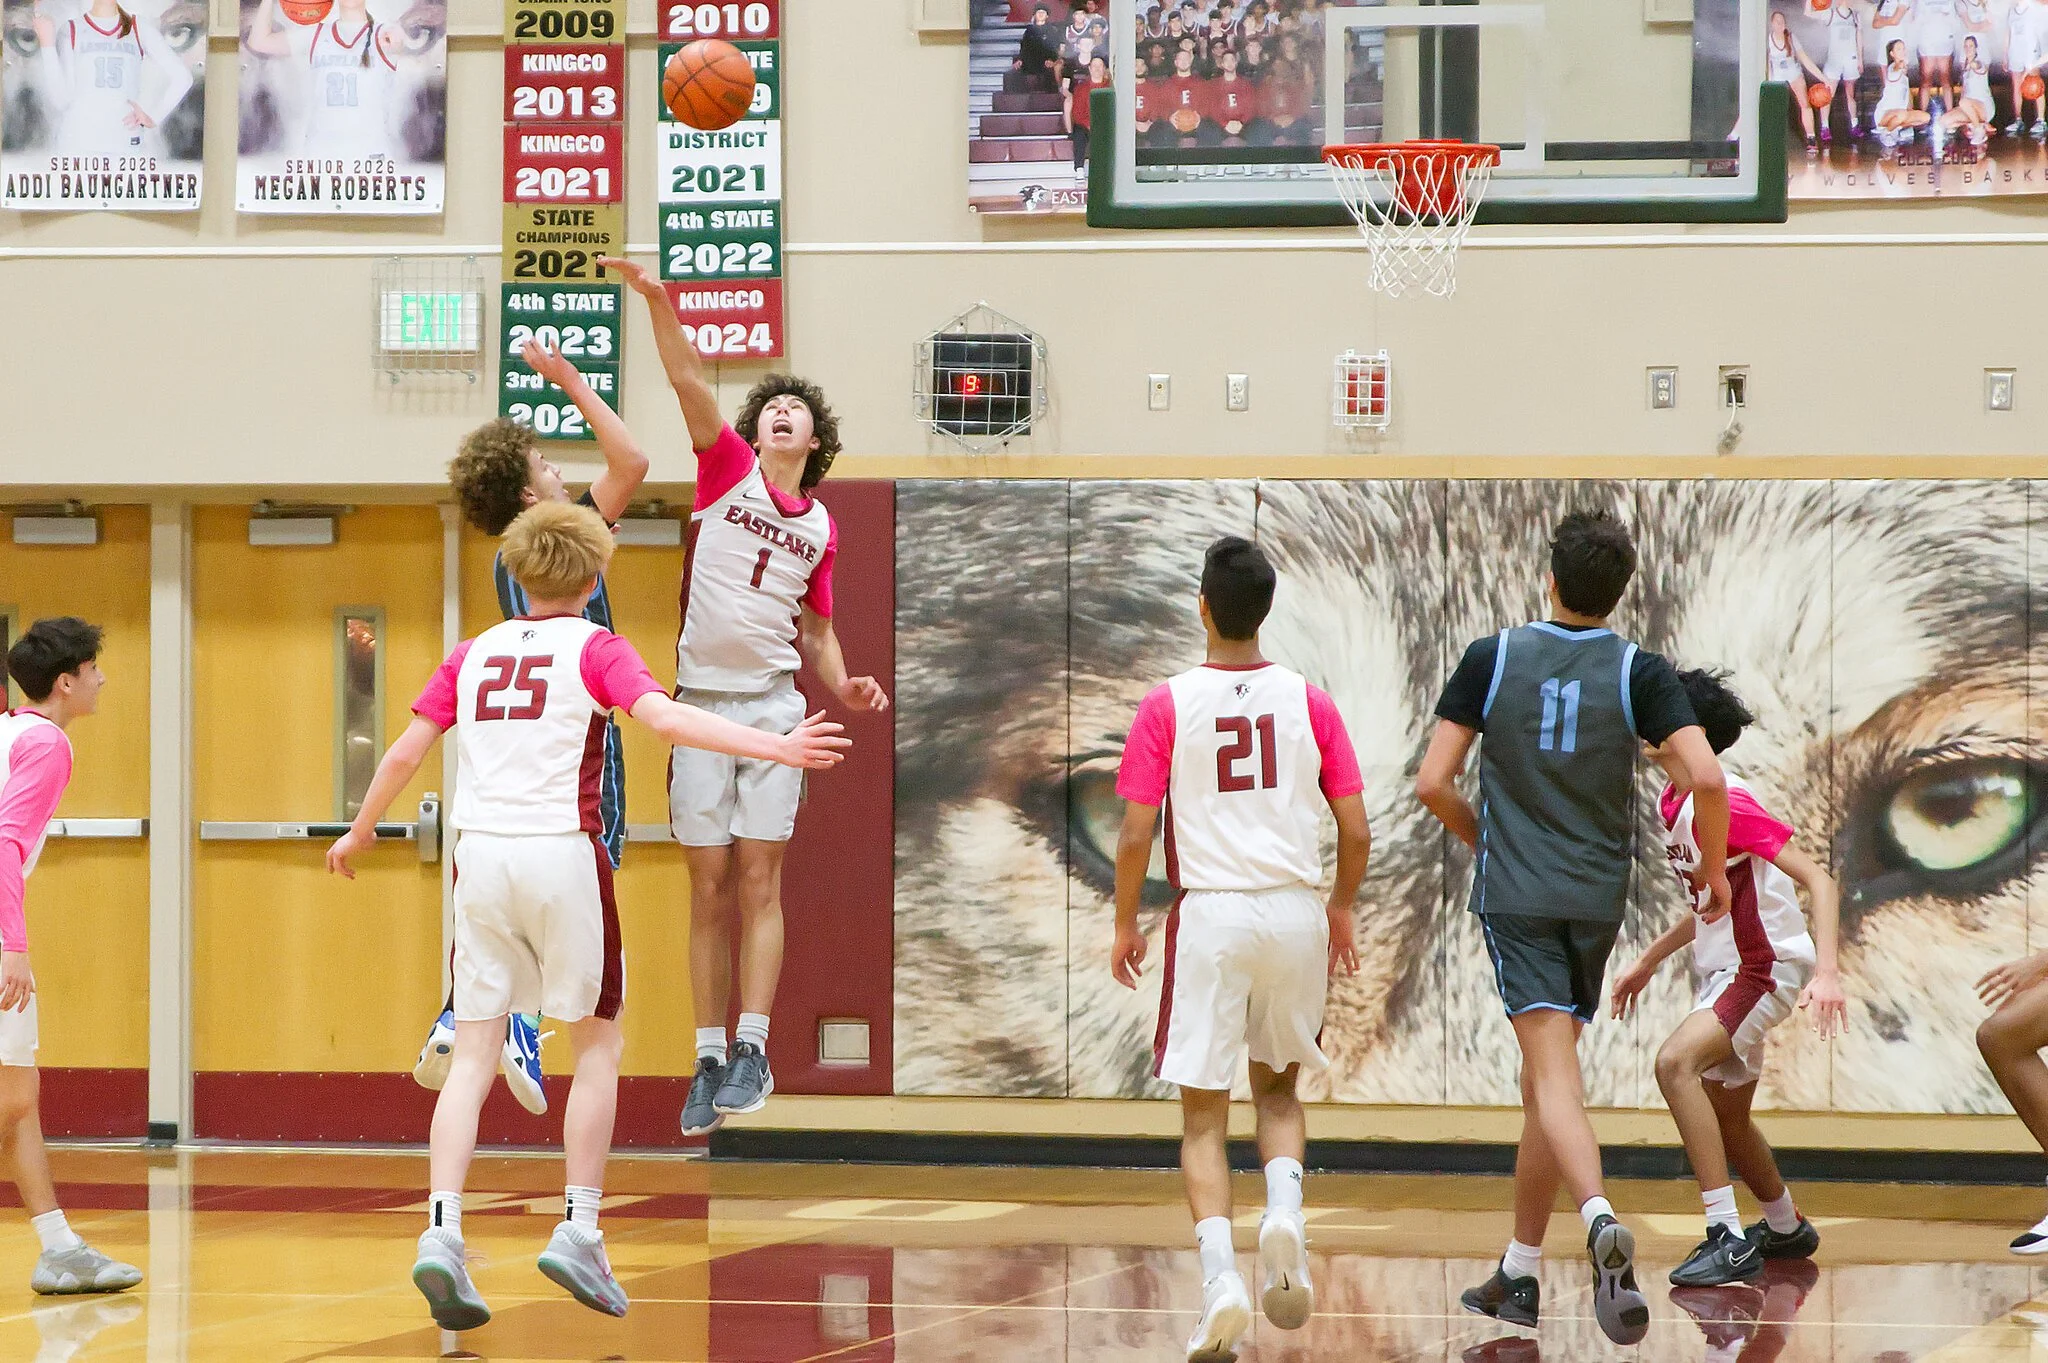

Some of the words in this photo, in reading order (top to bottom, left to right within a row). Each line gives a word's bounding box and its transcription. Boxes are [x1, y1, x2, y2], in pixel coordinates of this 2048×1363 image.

[514, 9, 615, 39] 2009
[668, 3, 771, 34] 2010
[94, 56, 124, 88] 15
[522, 53, 607, 72] KINGCO
[326, 71, 359, 107] 21
[513, 86, 616, 116] 2013
[1182, 89, 1191, 104] E
[1228, 93, 1238, 107] E
[521, 135, 605, 153] KINGCO
[669, 132, 767, 149] DISTRICT
[50, 157, 111, 171] SENIOR
[119, 157, 157, 171] 2026
[286, 160, 344, 174] SENIOR
[354, 160, 395, 174] 2026
[671, 164, 766, 193] 2021
[6, 174, 51, 199] ADDI
[60, 174, 198, 199] BAUMGARTNER
[254, 175, 321, 200] MEGAN
[331, 175, 427, 201] ROBERTS
[515, 168, 610, 197] 2021
[1824, 172, 1935, 187] WOLVES
[532, 209, 595, 226] STATE
[666, 211, 704, 229] 4th
[710, 209, 774, 228] STATE
[516, 231, 611, 244] CHAMPIONS
[513, 249, 609, 279] 2021
[668, 242, 774, 274] 2022
[508, 293, 545, 311] 4th
[552, 293, 616, 311] STATE
[679, 290, 765, 310] KINGCO
[401, 295, 462, 342] EXIT
[508, 324, 612, 356] 2023
[505, 372, 544, 390] 3rd
[508, 403, 593, 434] 202
[724, 504, 818, 564] EASTLAKE
[749, 547, 774, 589] 1
[475, 654, 555, 722] 25
[1539, 677, 1582, 753] 11
[1215, 713, 1278, 793] 21
